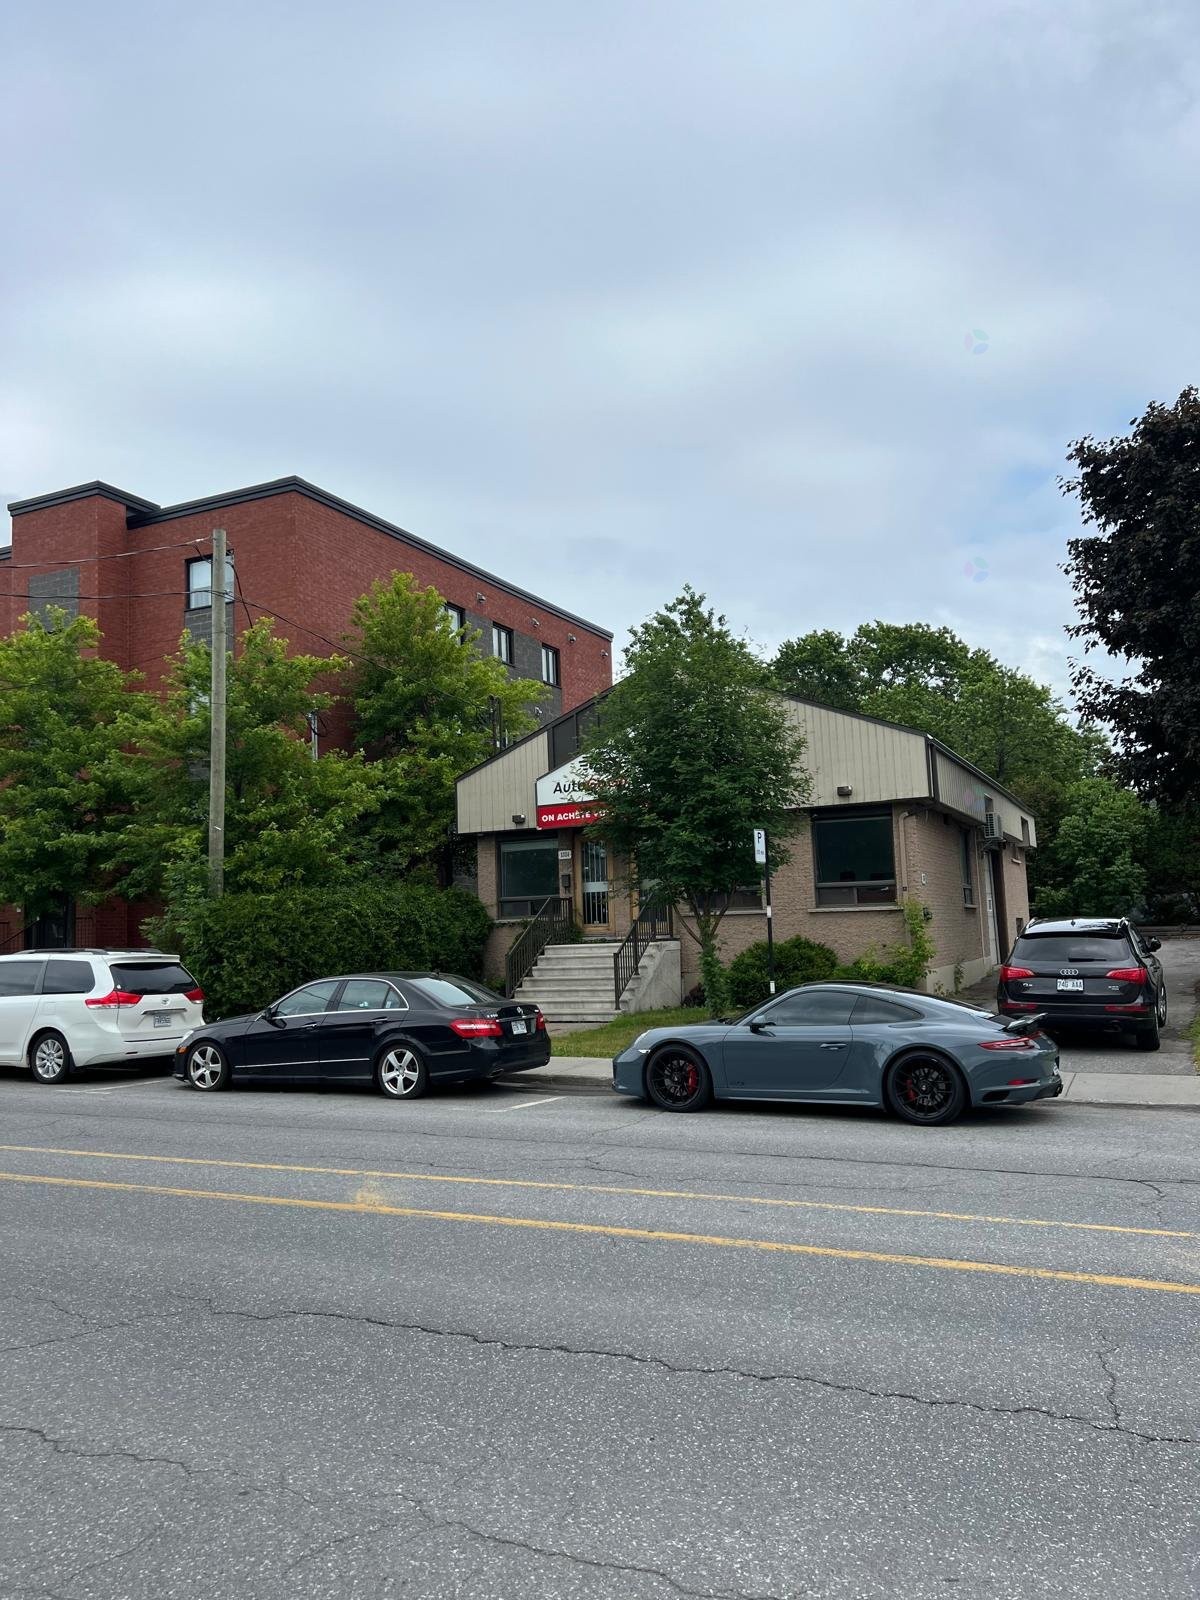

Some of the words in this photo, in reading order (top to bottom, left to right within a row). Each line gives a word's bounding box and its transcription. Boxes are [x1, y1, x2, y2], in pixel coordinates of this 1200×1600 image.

[541, 813, 555, 822] ON
[557, 810, 591, 821] ACHE
[757, 831, 762, 844] P
